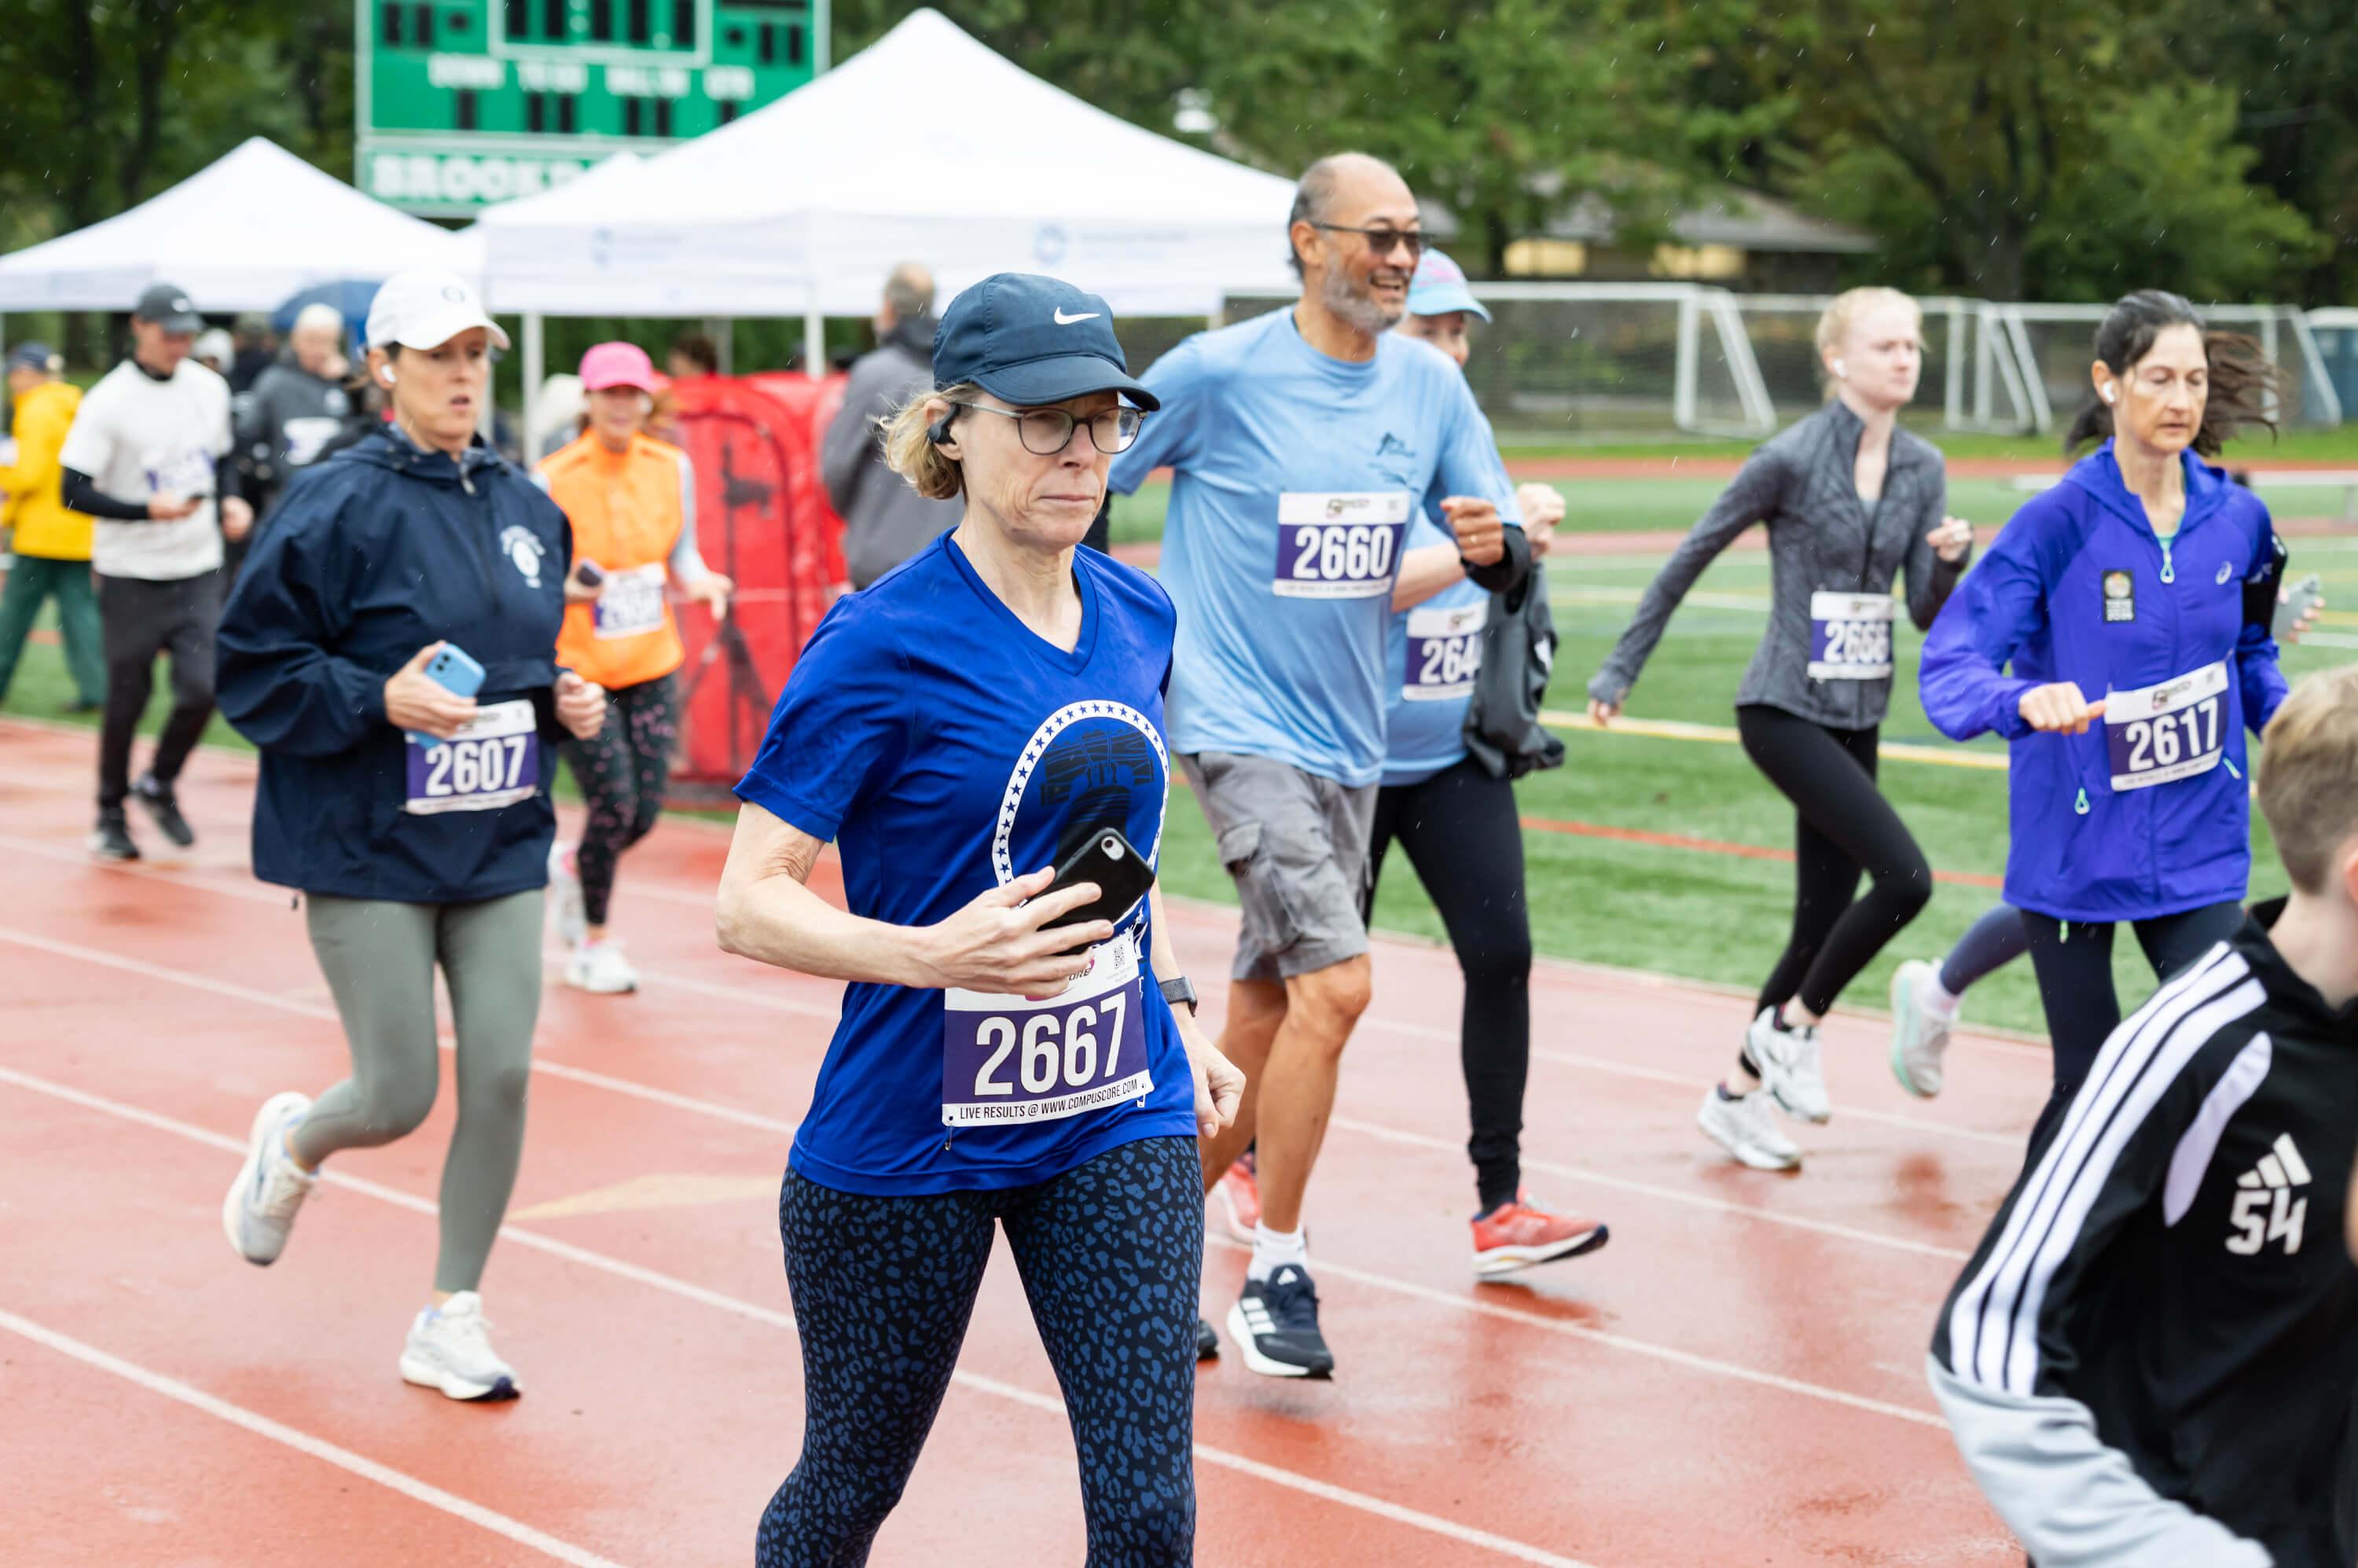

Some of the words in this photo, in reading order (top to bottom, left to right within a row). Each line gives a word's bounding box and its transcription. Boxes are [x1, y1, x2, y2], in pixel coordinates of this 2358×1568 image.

[1293, 525, 1394, 580] 2660
[1420, 634, 1482, 684] 264
[425, 734, 527, 796] 2607
[2125, 696, 2218, 772] 2617
[974, 991, 1126, 1096] 2667
[960, 1107, 980, 1119] LIVE
[983, 1104, 1026, 1118] RESULTS
[1027, 1103, 1038, 1117] @
[1041, 1080, 1138, 1115] WWW.COMPUSCORE.COM
[2224, 1187, 2308, 1256] 54
